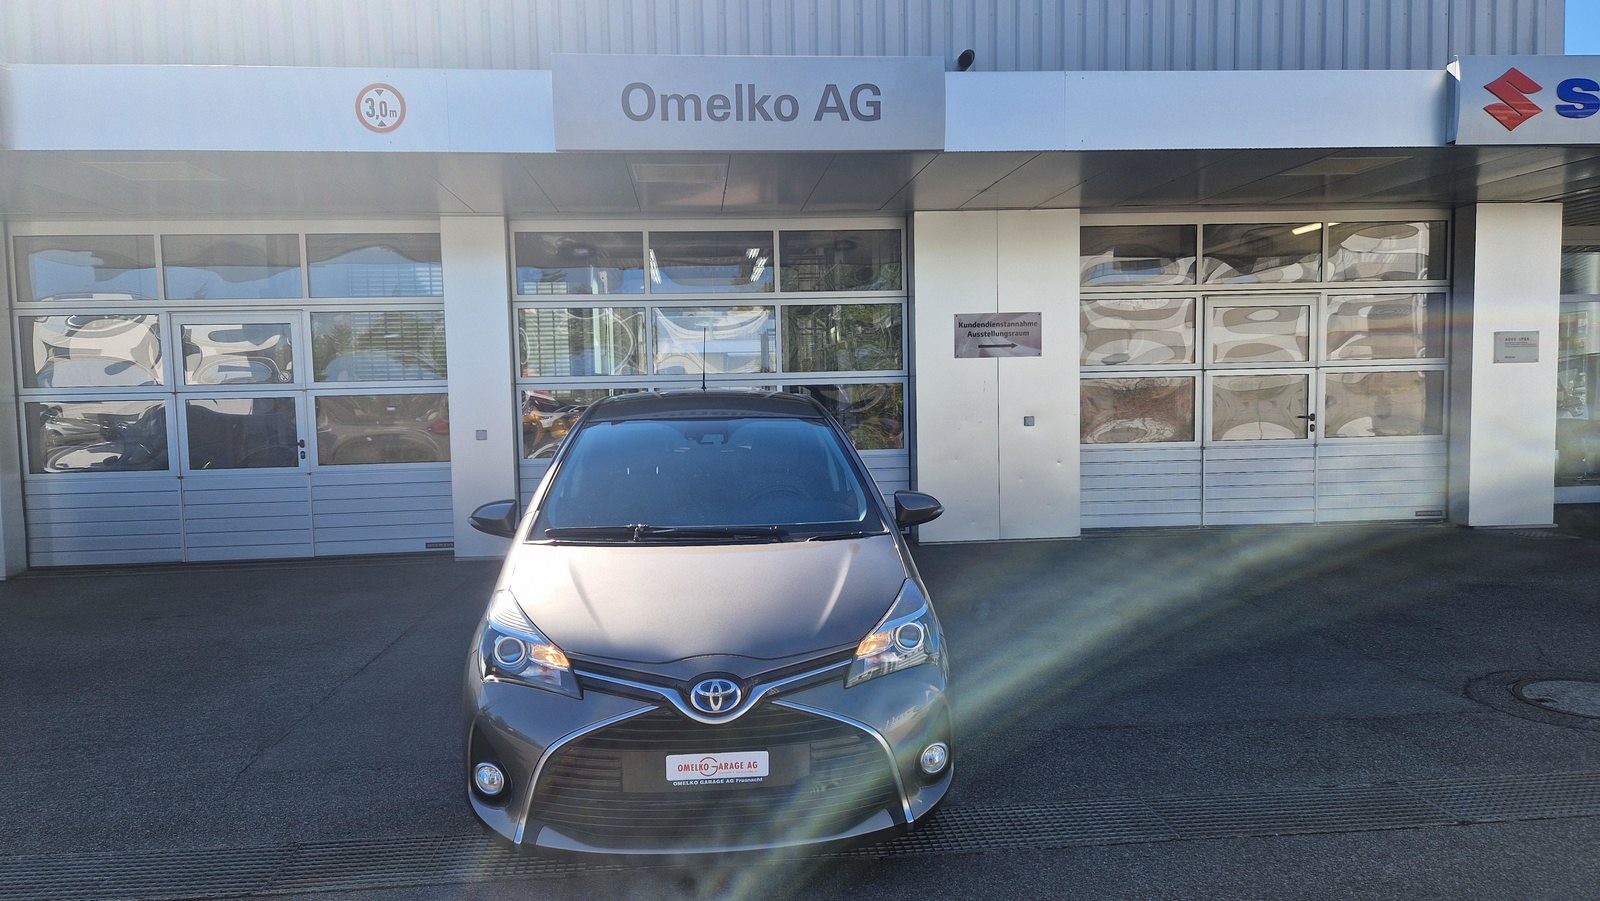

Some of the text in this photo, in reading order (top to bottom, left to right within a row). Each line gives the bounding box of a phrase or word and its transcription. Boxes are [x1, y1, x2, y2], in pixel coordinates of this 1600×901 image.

[621, 82, 882, 122] Omelko AG
[958, 320, 1038, 329] Kundendienstannahme
[967, 330, 1030, 338] Ausstellungsraum
[677, 763, 709, 772] OMELKO
[747, 761, 758, 769] AG
